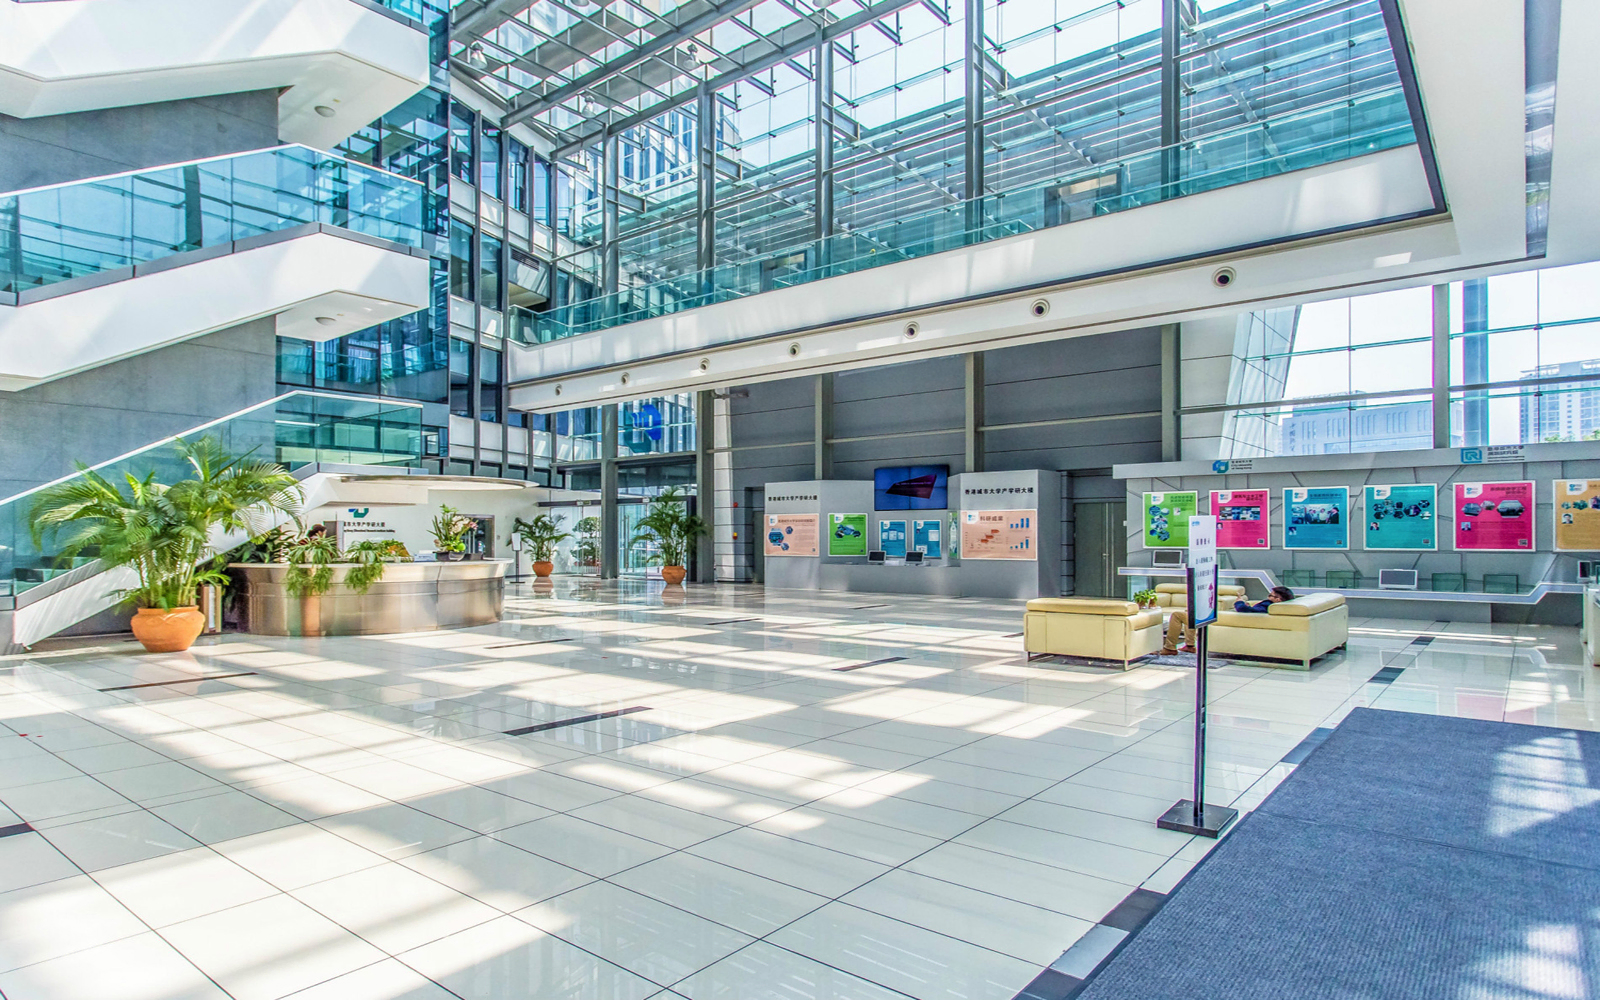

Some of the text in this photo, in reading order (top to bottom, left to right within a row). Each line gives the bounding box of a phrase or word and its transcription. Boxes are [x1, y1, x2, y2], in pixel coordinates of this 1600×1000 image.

[965, 487, 1034, 495] 香港城市大学产学研大楼
